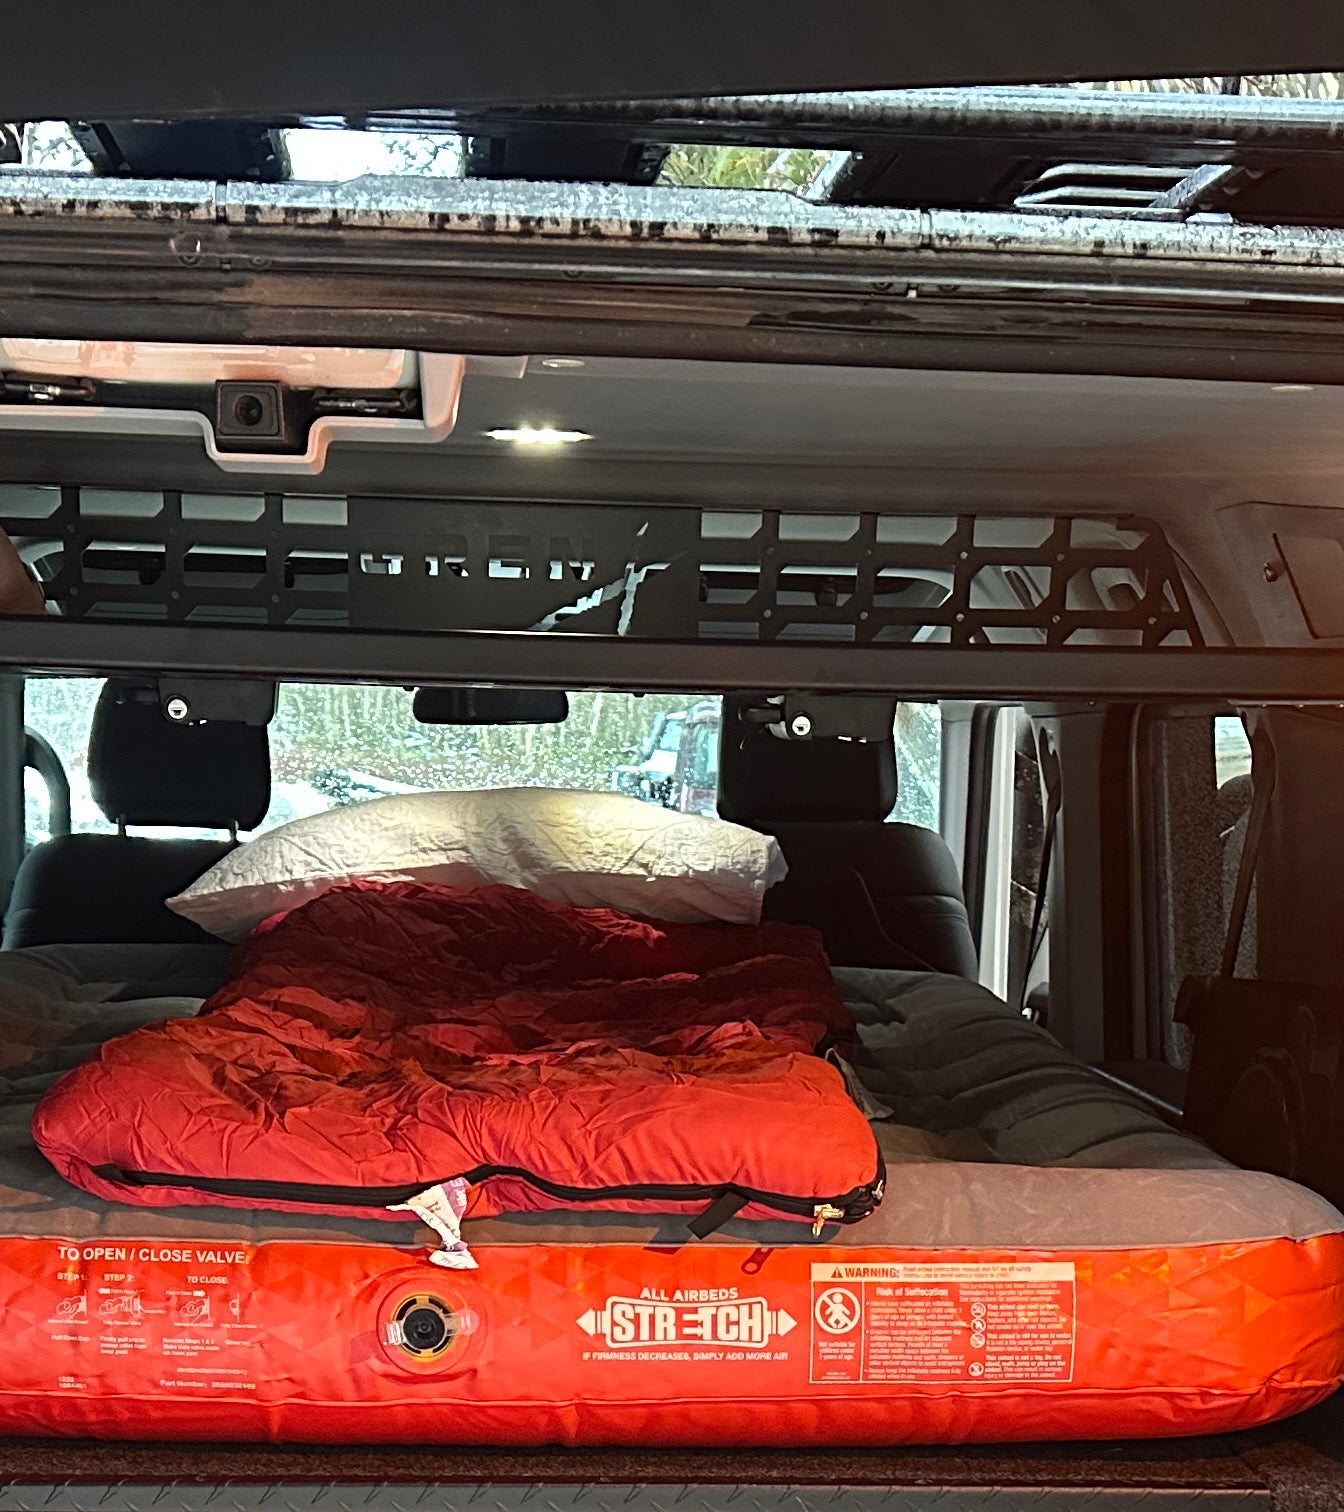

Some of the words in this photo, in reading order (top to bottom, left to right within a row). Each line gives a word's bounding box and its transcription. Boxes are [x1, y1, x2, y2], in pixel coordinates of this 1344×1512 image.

[57, 1246, 79, 1261] TO
[83, 1247, 127, 1261] OPEN
[139, 1248, 192, 1263] CLOSE
[640, 1287, 669, 1301] ALL
[672, 1287, 739, 1302] AIRBEDS
[612, 1303, 762, 1342] STRETCH
[582, 1351, 591, 1361] IF
[592, 1351, 637, 1361] FIRMNESS
[693, 1351, 724, 1361] SIMPLY
[725, 1351, 744, 1361] ADD
[745, 1351, 772, 1361] MORE
